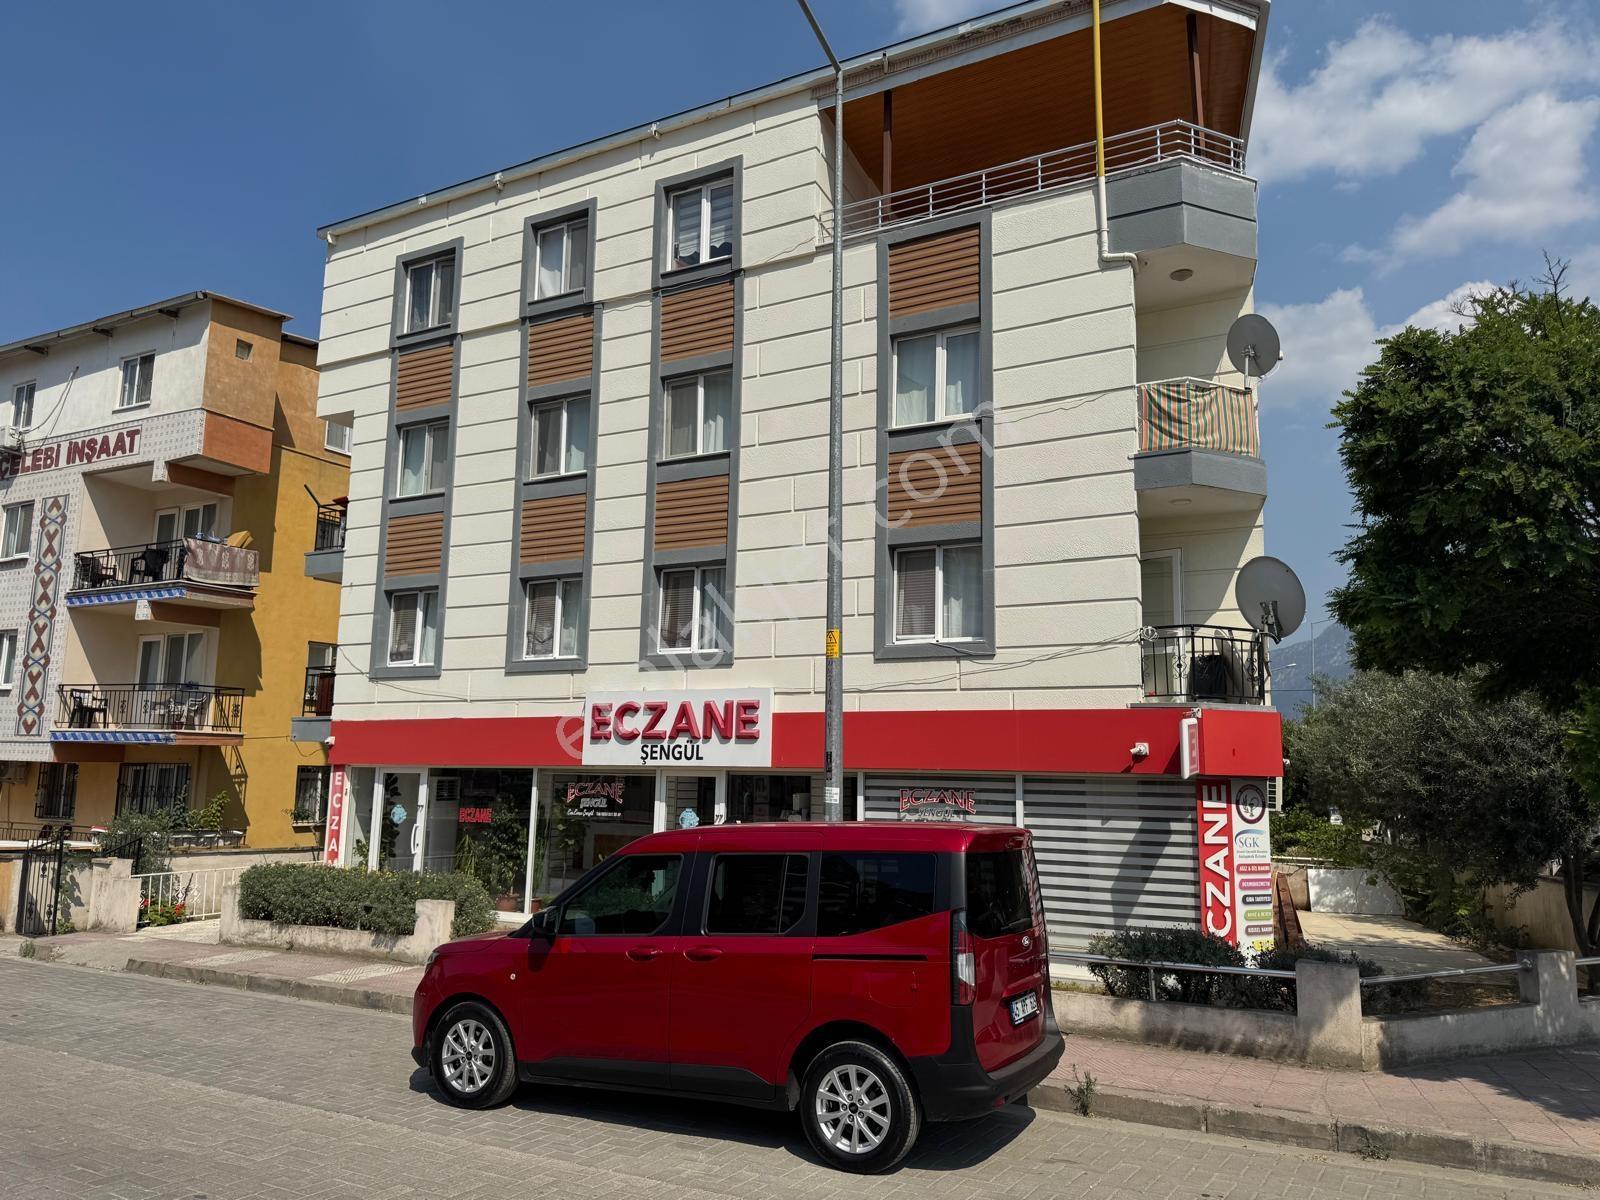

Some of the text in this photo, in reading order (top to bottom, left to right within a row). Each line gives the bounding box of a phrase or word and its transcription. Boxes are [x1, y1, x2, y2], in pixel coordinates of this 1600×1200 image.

[65, 428, 141, 465] İNŞAAT
[590, 699, 761, 741] ECZANE
[640, 740, 704, 765] ŞENGÜL
[567, 782, 625, 804] ECZANE
[899, 788, 977, 815] ECZANE
[327, 771, 342, 865] ECZA
[459, 807, 493, 823] ECZANE
[1238, 836, 1260, 849] SGK
[1202, 784, 1232, 945] CZANE
